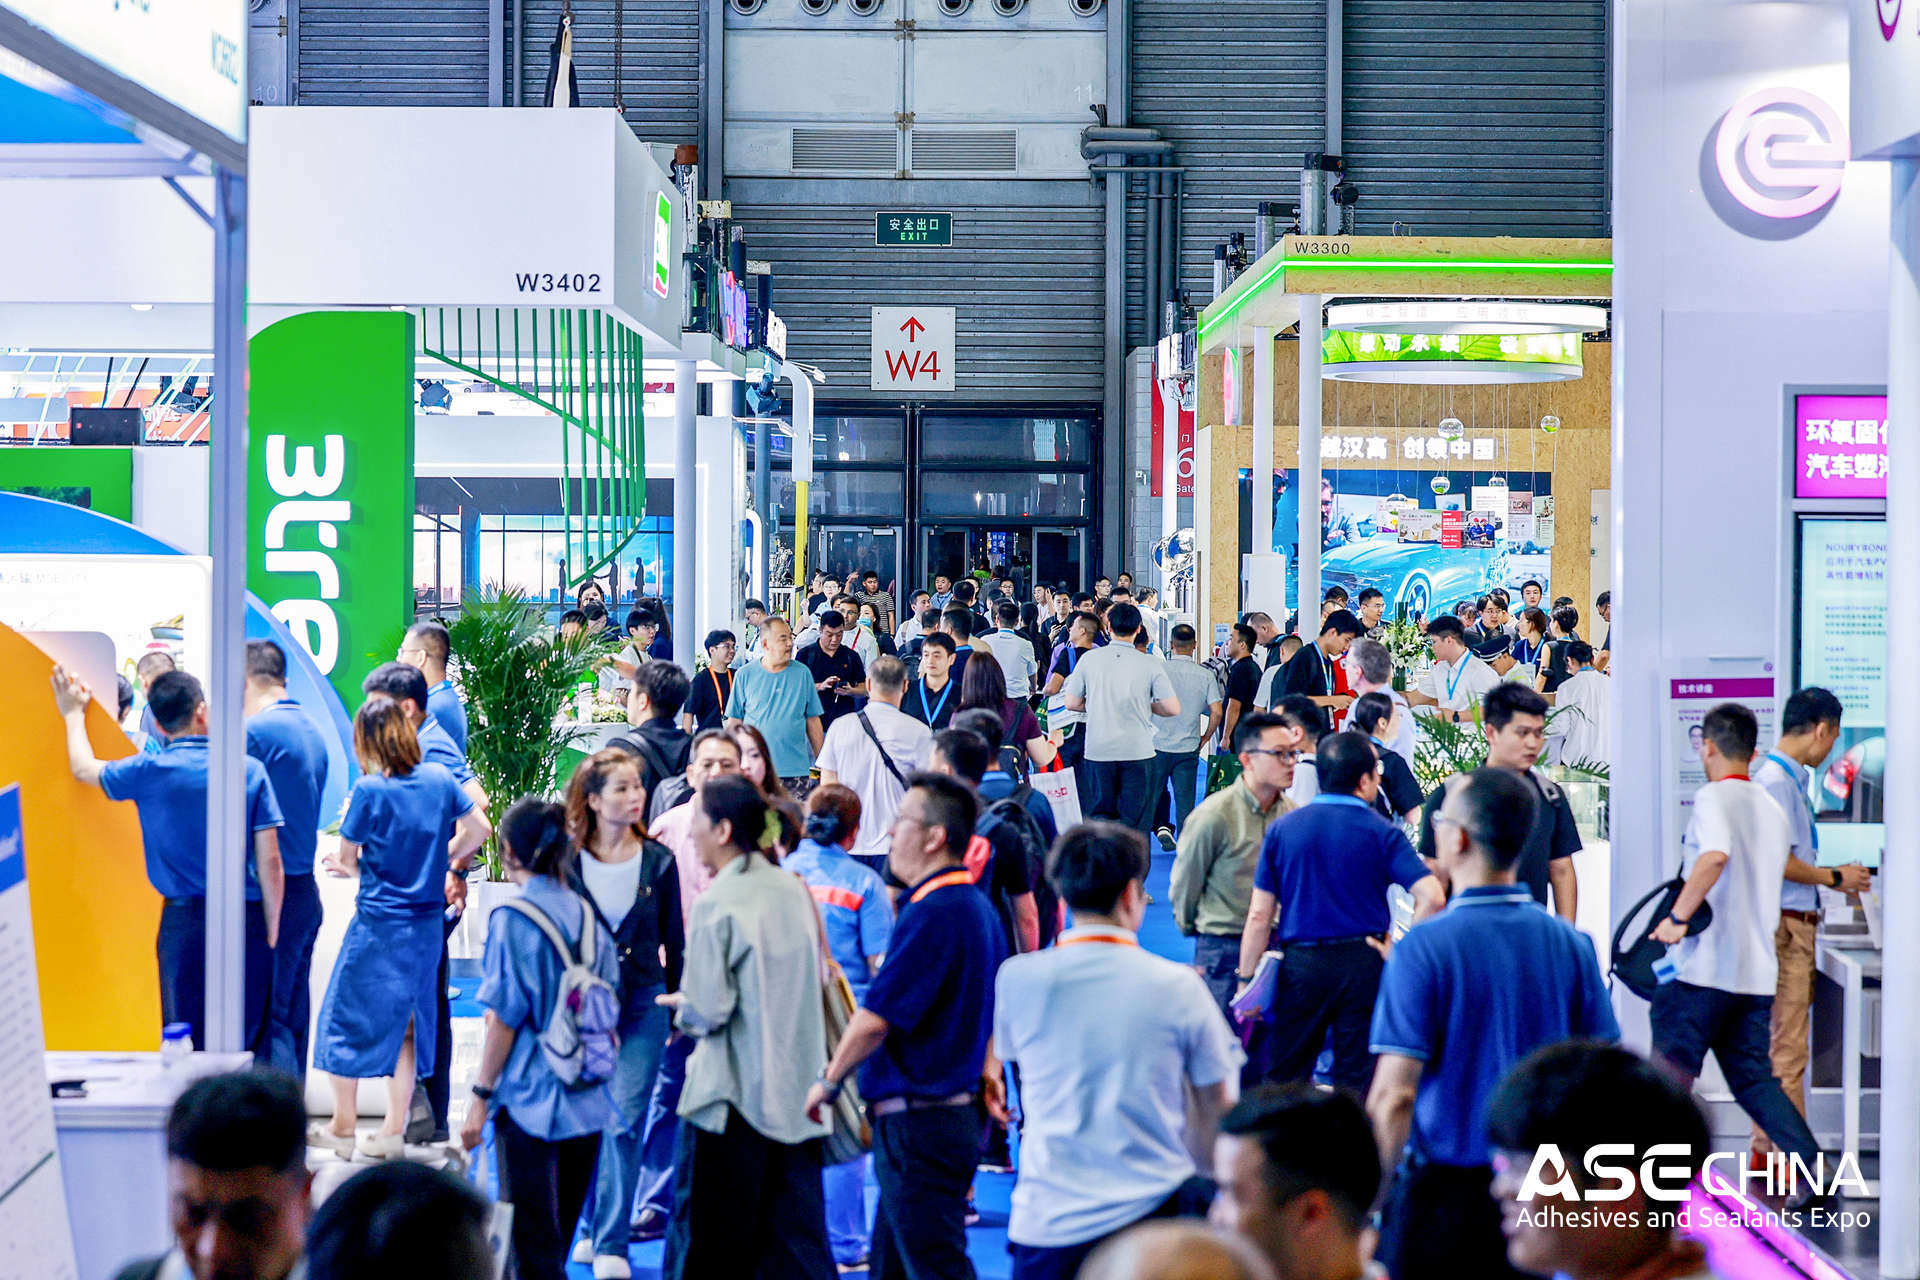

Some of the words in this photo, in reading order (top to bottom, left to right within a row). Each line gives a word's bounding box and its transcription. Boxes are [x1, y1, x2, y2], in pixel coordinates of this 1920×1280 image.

[1073, 84, 1092, 102] 11
[889, 217, 939, 231] 安全出口
[900, 232, 928, 241] EXIT
[1295, 242, 1350, 255] W3300
[516, 273, 601, 292] W3402
[884, 350, 941, 382] W4
[1181, 434, 1190, 443] 门
[1319, 435, 1388, 459] 越汉高
[1402, 435, 1495, 460] 创领中国
[1177, 447, 1194, 479] 6
